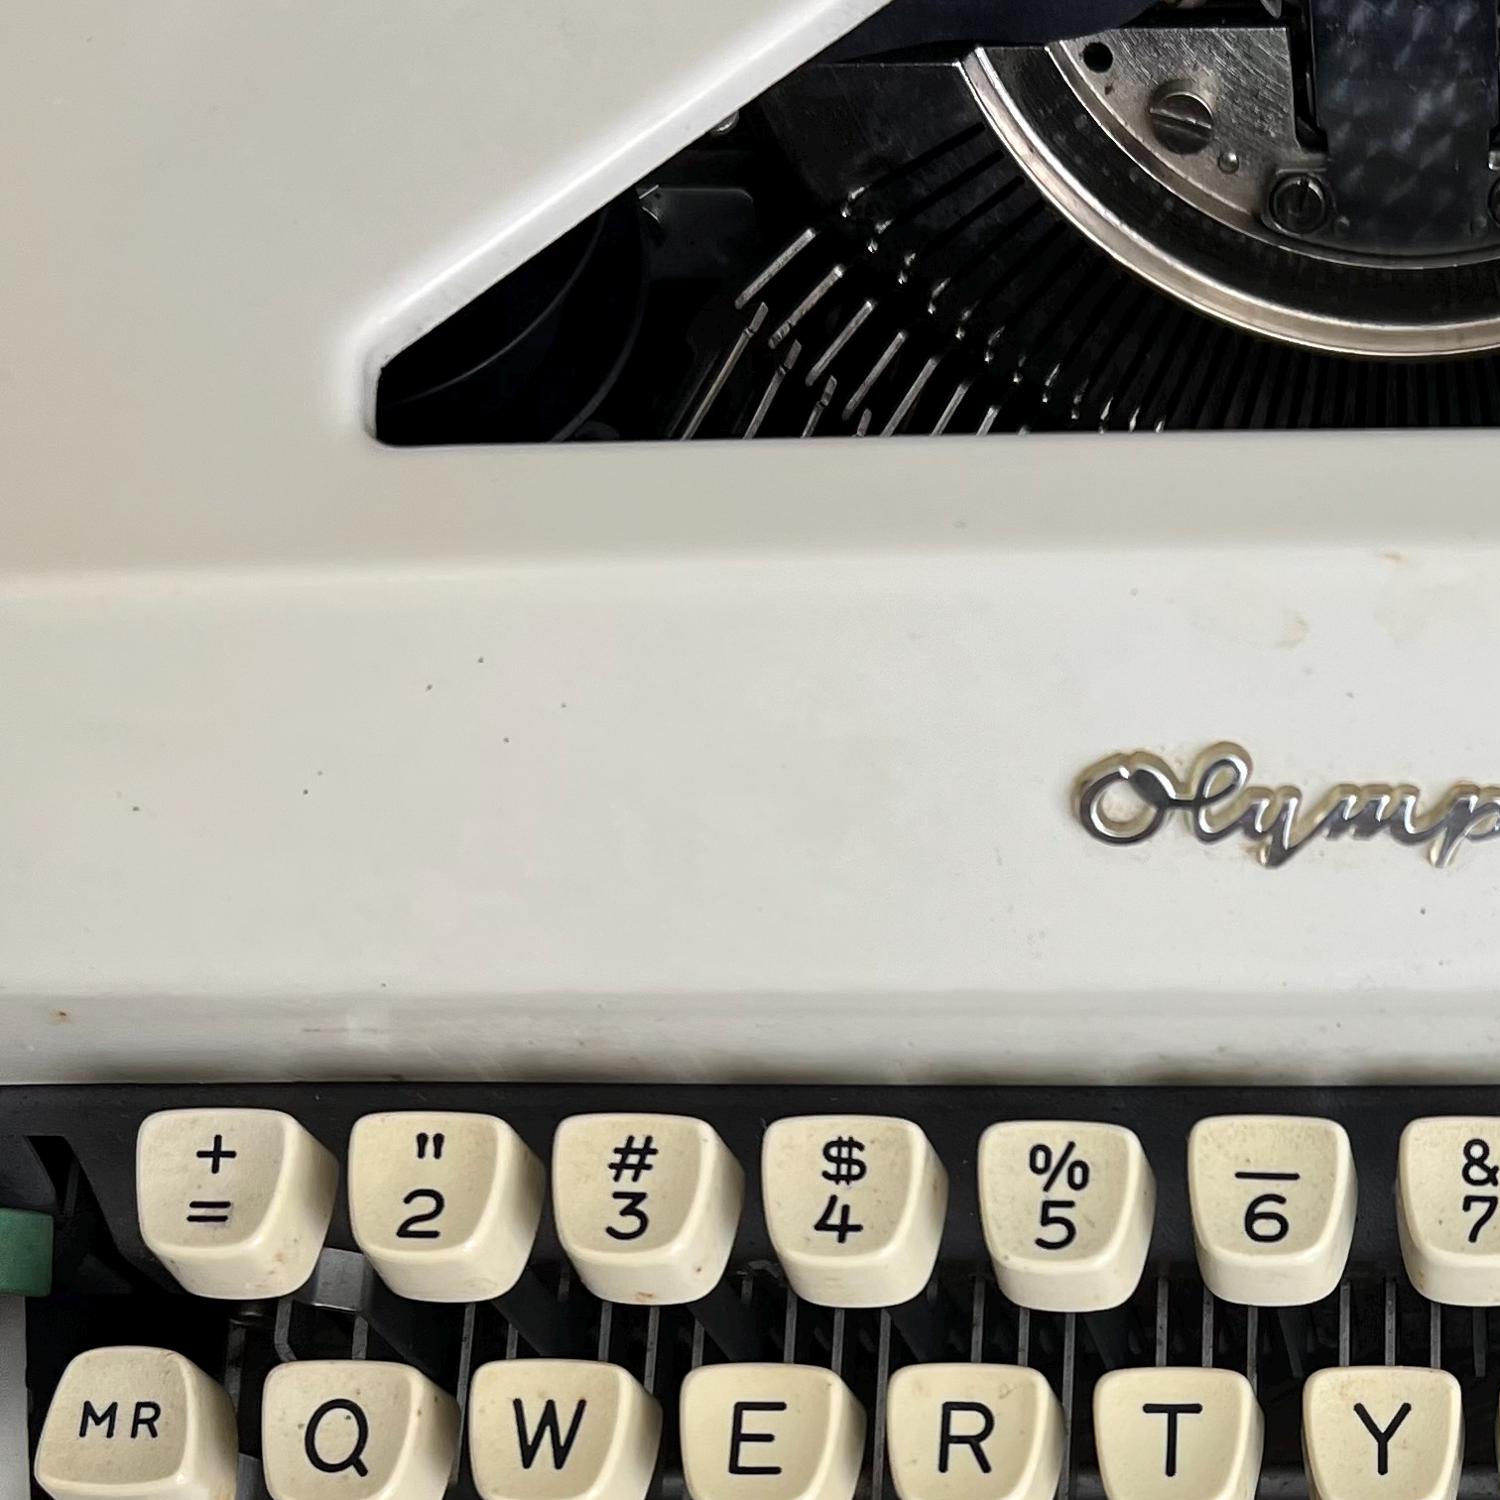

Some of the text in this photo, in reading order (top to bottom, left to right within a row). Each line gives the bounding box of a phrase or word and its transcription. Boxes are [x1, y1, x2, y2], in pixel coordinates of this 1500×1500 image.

[196, 1135, 237, 1174] +
[608, 1135, 658, 1182] #
[822, 1136, 866, 1185] $
[1029, 1141, 1089, 1192] %
[1462, 1139, 1499, 1186] &
[396, 1189, 444, 1239] 2
[606, 1192, 649, 1240] 3
[814, 1195, 863, 1243] 4
[1035, 1200, 1076, 1250] 5
[1245, 1194, 1289, 1243] 6
[1463, 1195, 1498, 1243] 7
[79, 1401, 161, 1439] MR
[305, 1399, 368, 1477] Q
[513, 1398, 586, 1470] W
[729, 1402, 787, 1475] E
[938, 1402, 994, 1473] R
[1143, 1404, 1202, 1477] T
[1354, 1403, 1411, 1475] Y
